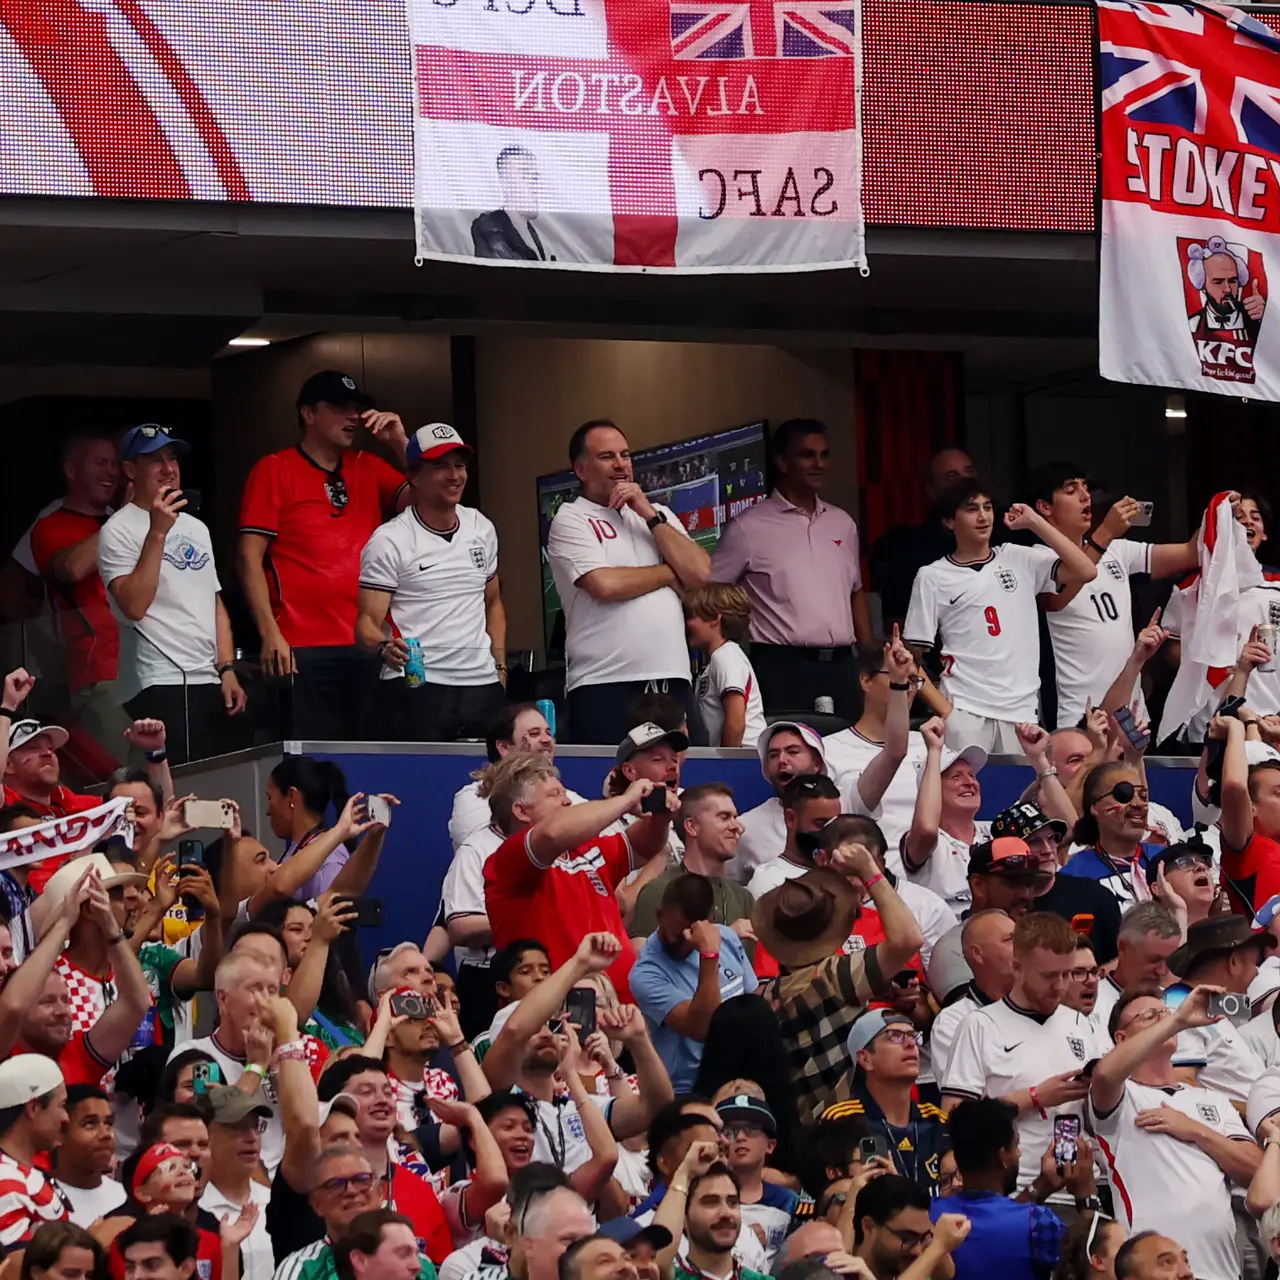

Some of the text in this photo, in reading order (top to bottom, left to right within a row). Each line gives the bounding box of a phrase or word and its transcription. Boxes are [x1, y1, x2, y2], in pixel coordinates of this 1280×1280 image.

[1196, 340, 1252, 368] KFC
[588, 518, 617, 544] 10
[984, 606, 1001, 636] 9
[1090, 592, 1119, 623] 10
